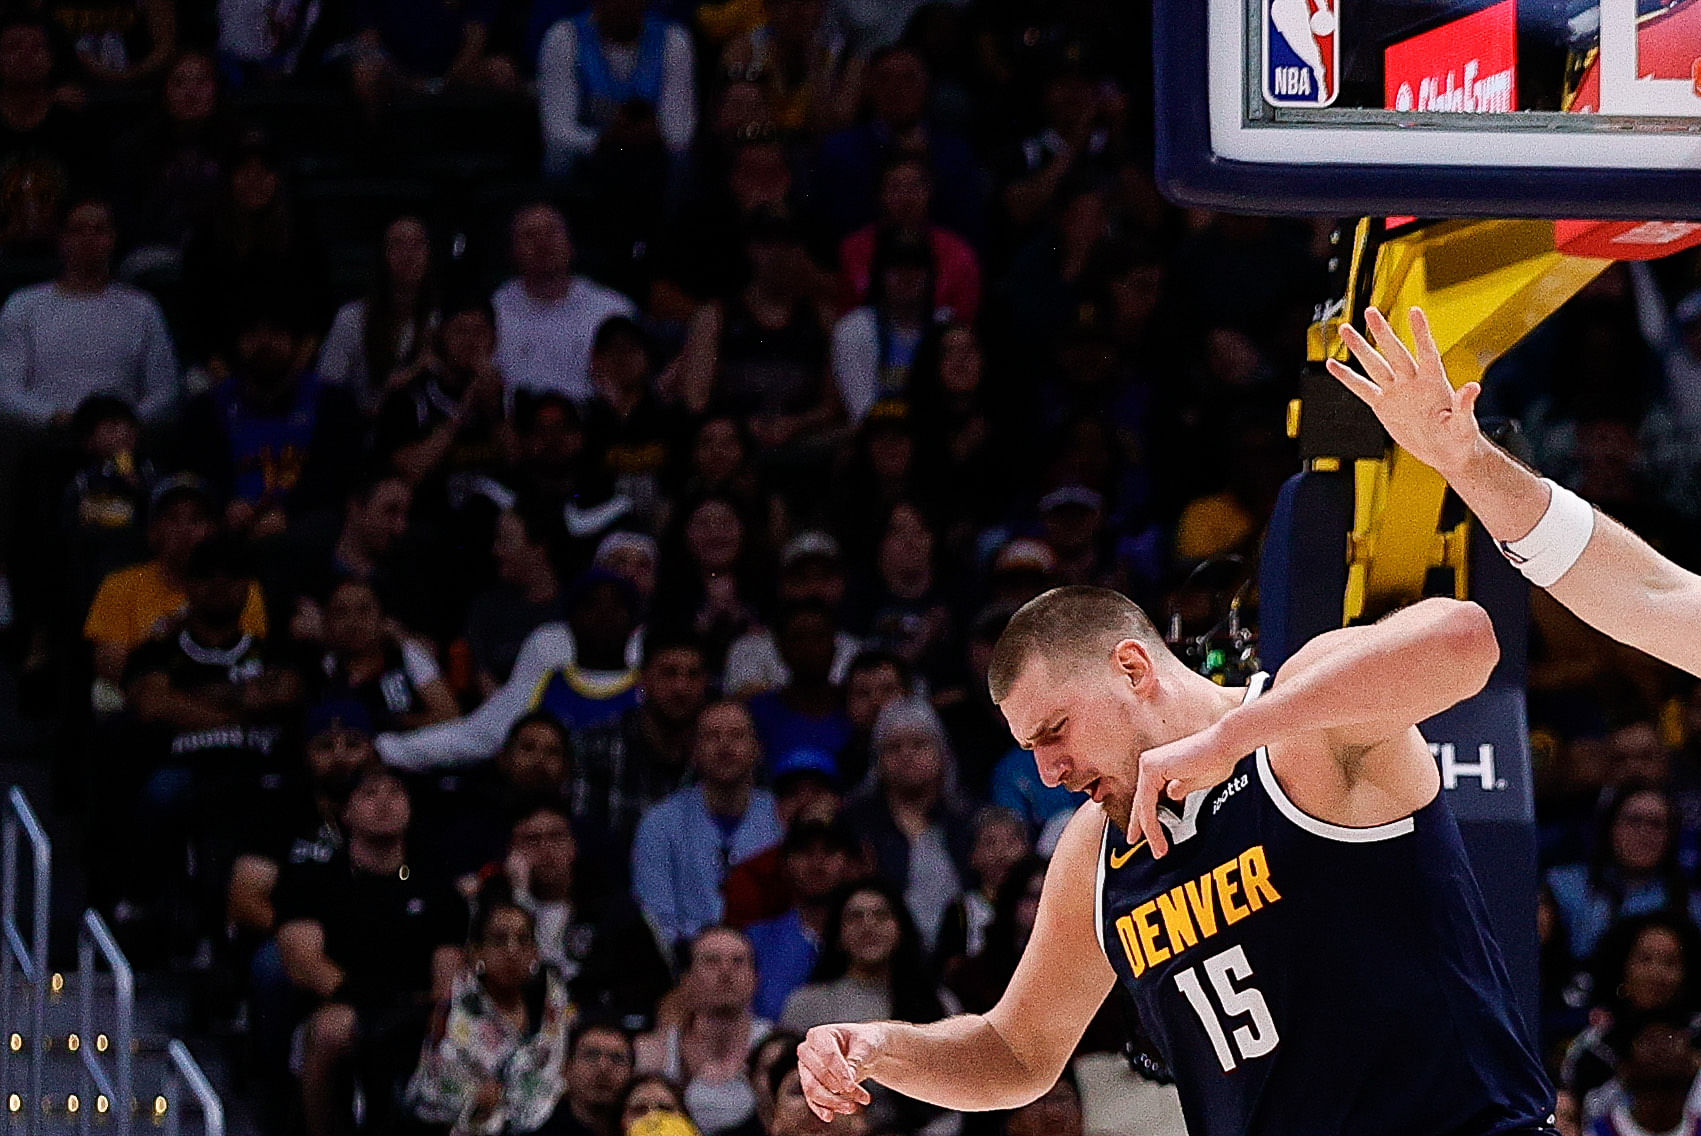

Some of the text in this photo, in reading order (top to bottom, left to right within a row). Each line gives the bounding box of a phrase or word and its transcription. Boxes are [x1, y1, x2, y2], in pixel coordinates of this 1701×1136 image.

[1274, 66, 1311, 96] NBA
[1115, 845, 1282, 979] DENVER
[1173, 944, 1280, 1073] 15
